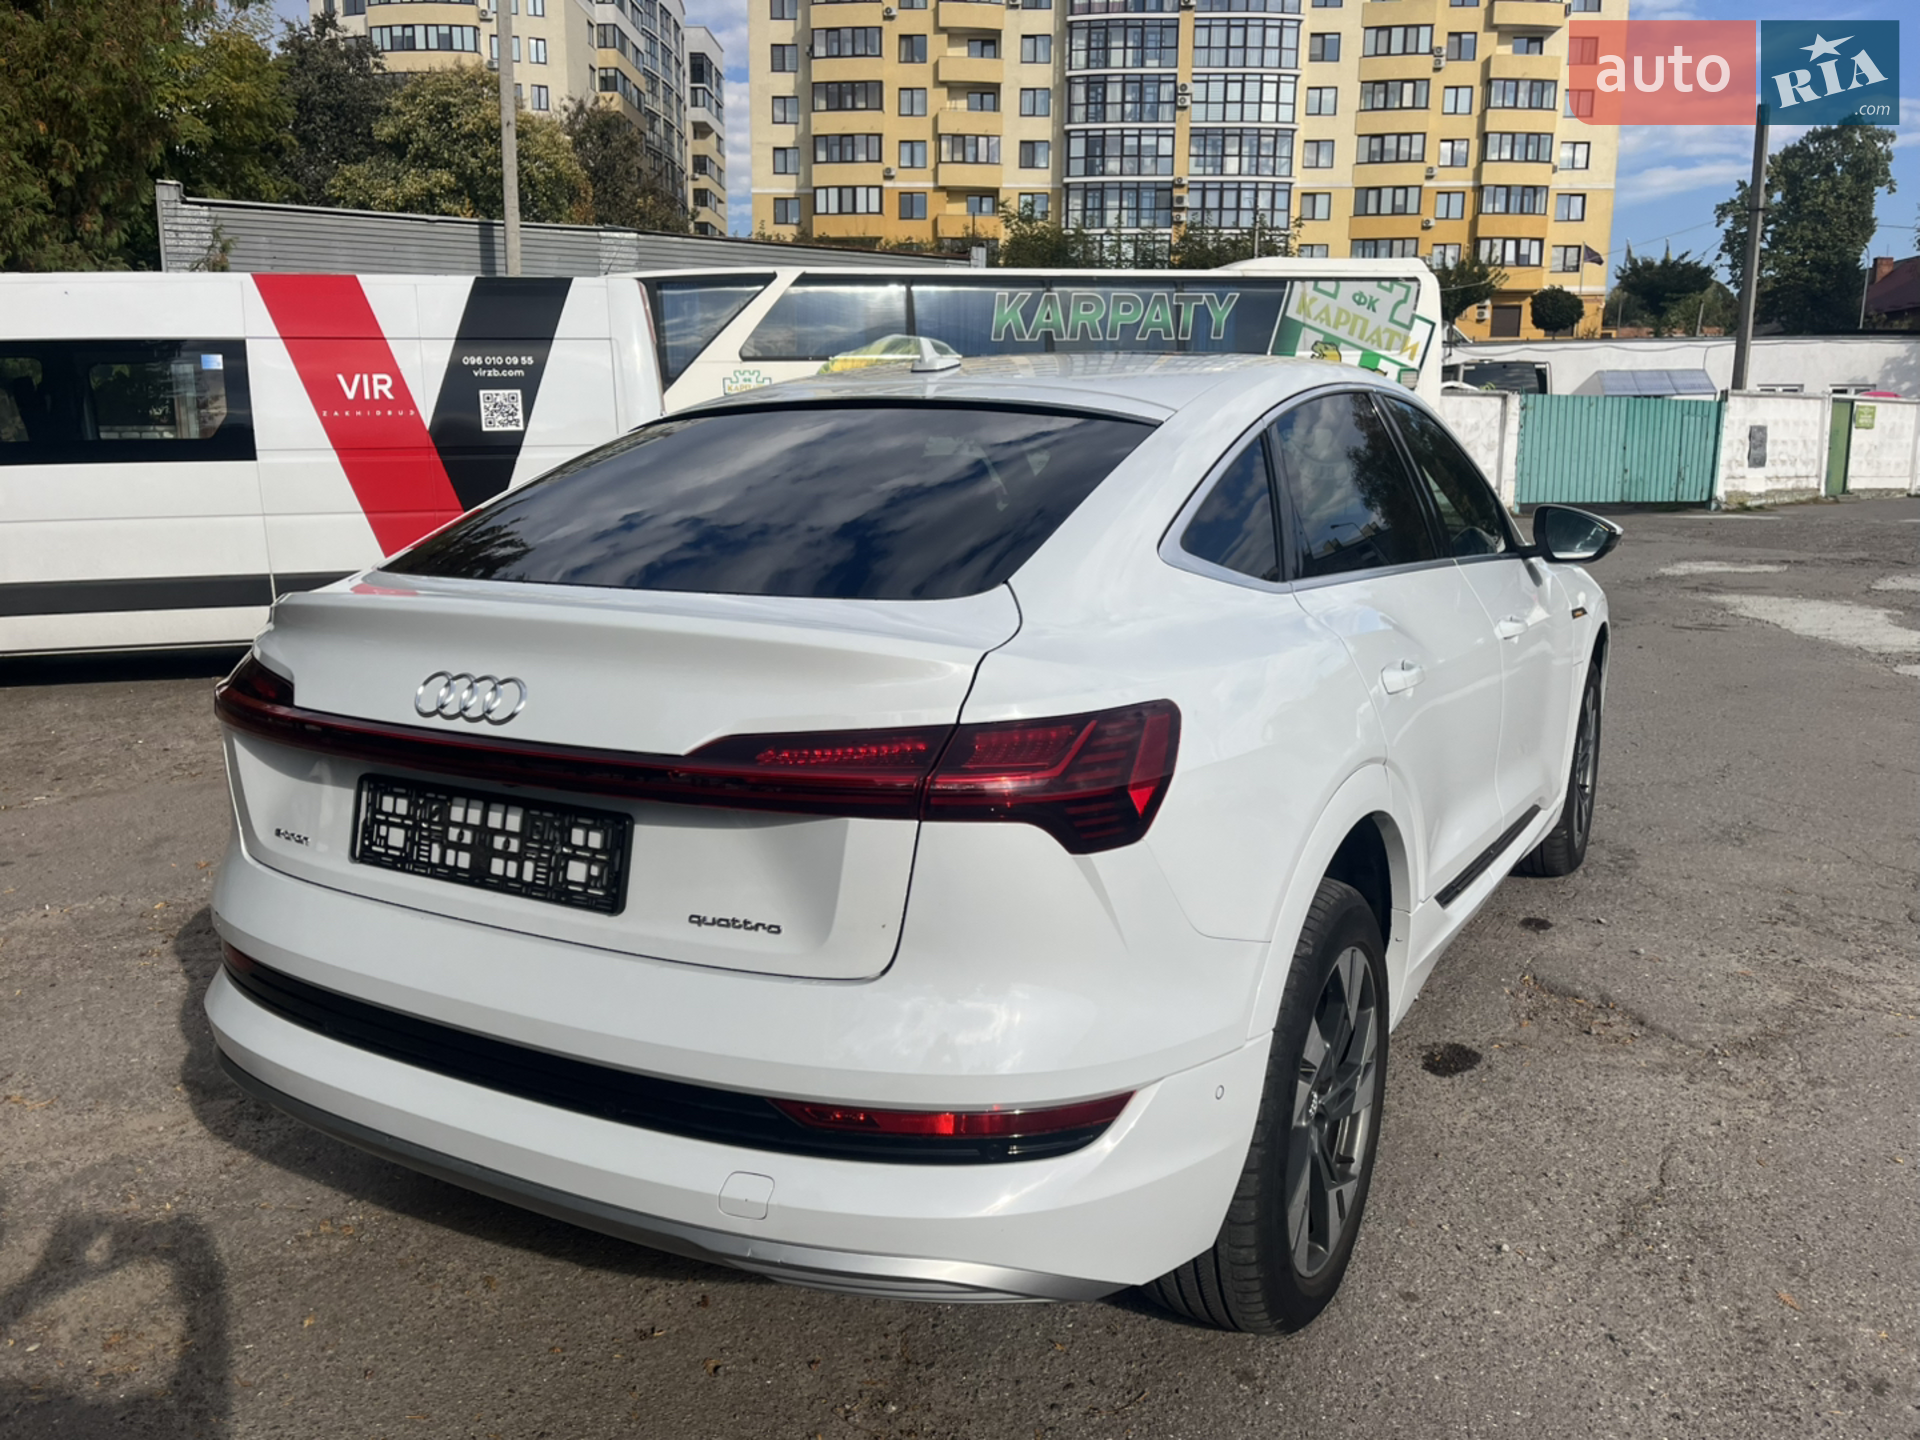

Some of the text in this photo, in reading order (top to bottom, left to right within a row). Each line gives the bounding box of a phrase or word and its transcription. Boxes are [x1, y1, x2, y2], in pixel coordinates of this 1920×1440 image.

[990, 292, 1240, 342] KARPATY
[1295, 293, 1421, 362] КАРПАТИ
[462, 356, 534, 366] 096 010 09 55
[472, 368, 525, 377] virzb.com
[336, 373, 395, 400] VIR
[688, 914, 782, 935] quattro
